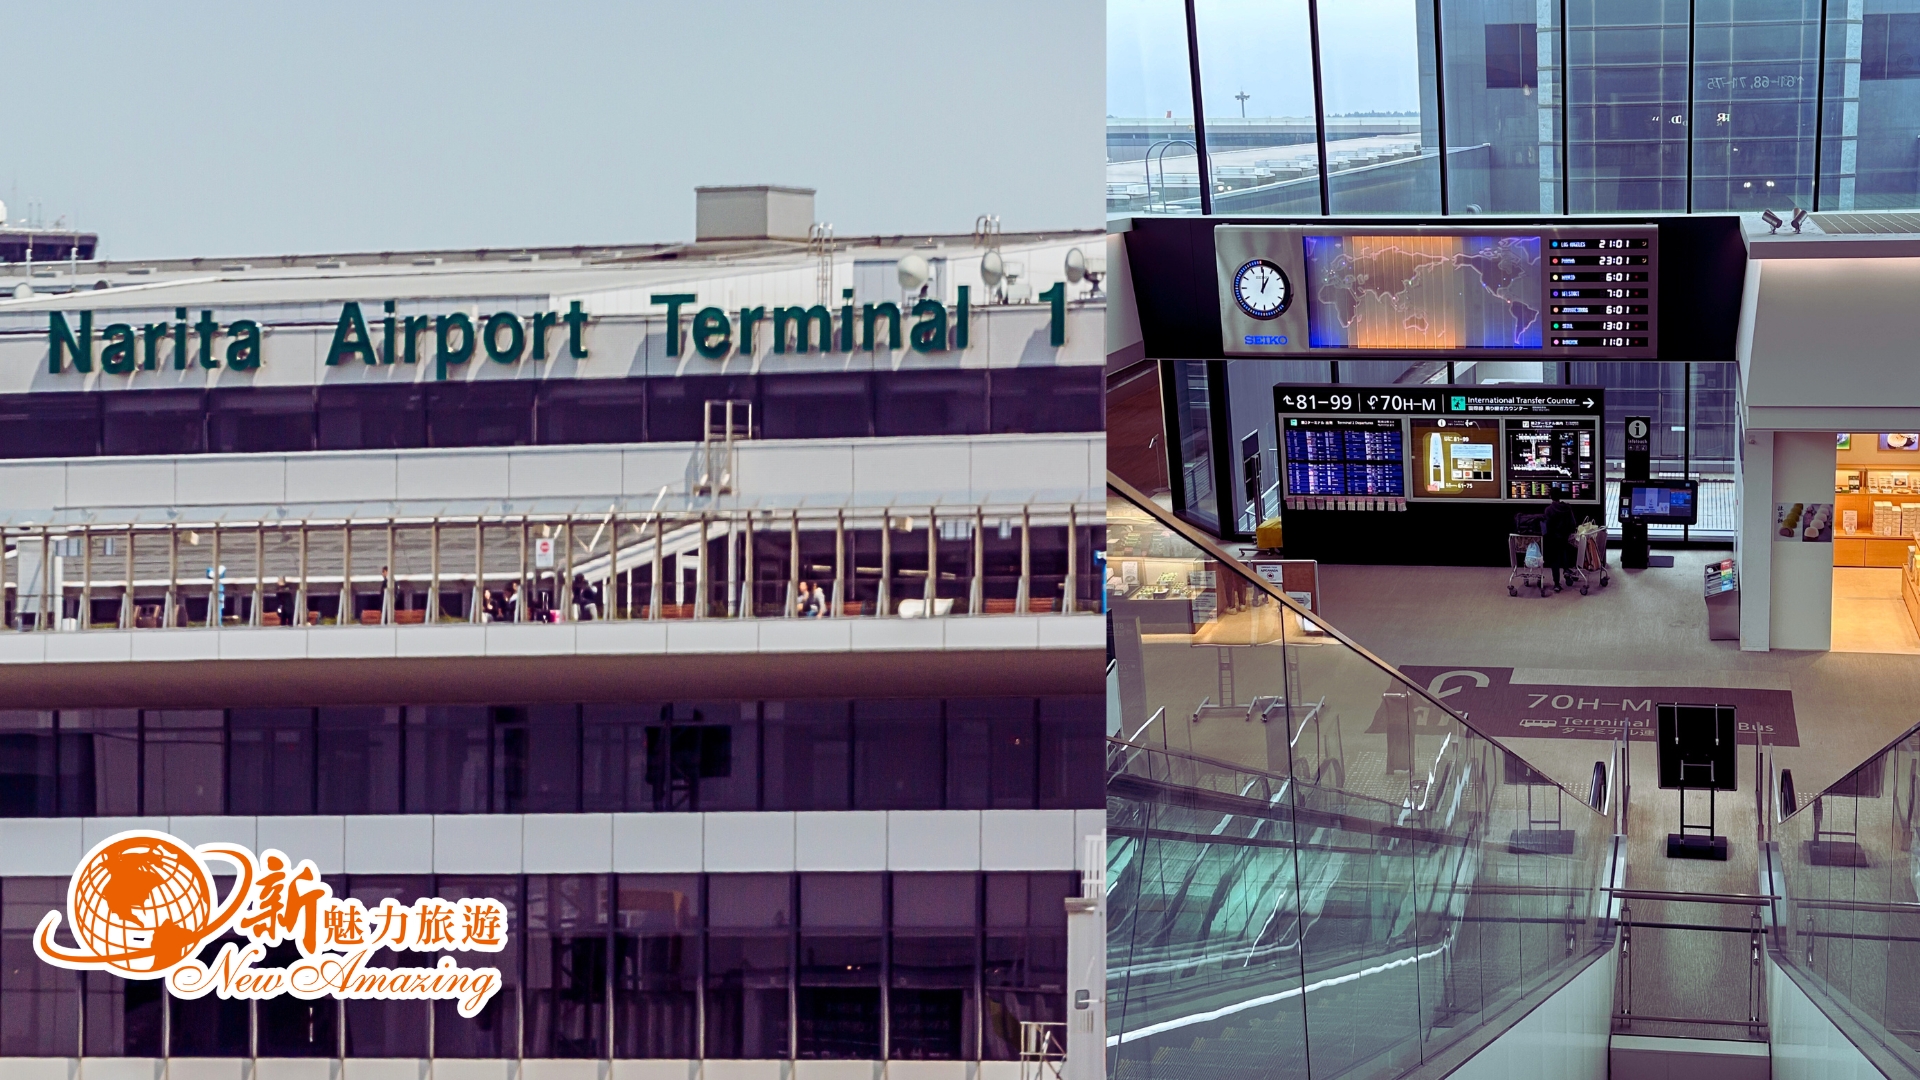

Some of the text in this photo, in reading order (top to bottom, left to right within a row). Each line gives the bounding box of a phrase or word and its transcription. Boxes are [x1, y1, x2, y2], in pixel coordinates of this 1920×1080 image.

[1599, 240, 1630, 248] 21:01
[1599, 256, 1630, 265] 23:01
[1606, 273, 1630, 281] 6:01
[1607, 289, 1630, 297] 7:01
[1606, 306, 1630, 314] 6:01
[1603, 322, 1630, 330] 13:01
[49, 282, 1065, 380] Narita Airport Terminal 1
[1244, 335, 1288, 345] SEIKO
[1603, 338, 1630, 347] 11:01
[1296, 395, 1352, 410] 81-99
[1380, 395, 1436, 411] 70H-M
[1527, 693, 1652, 712] 70H-M
[1561, 716, 1651, 728] Terminal
[1738, 722, 1774, 732] Bus
